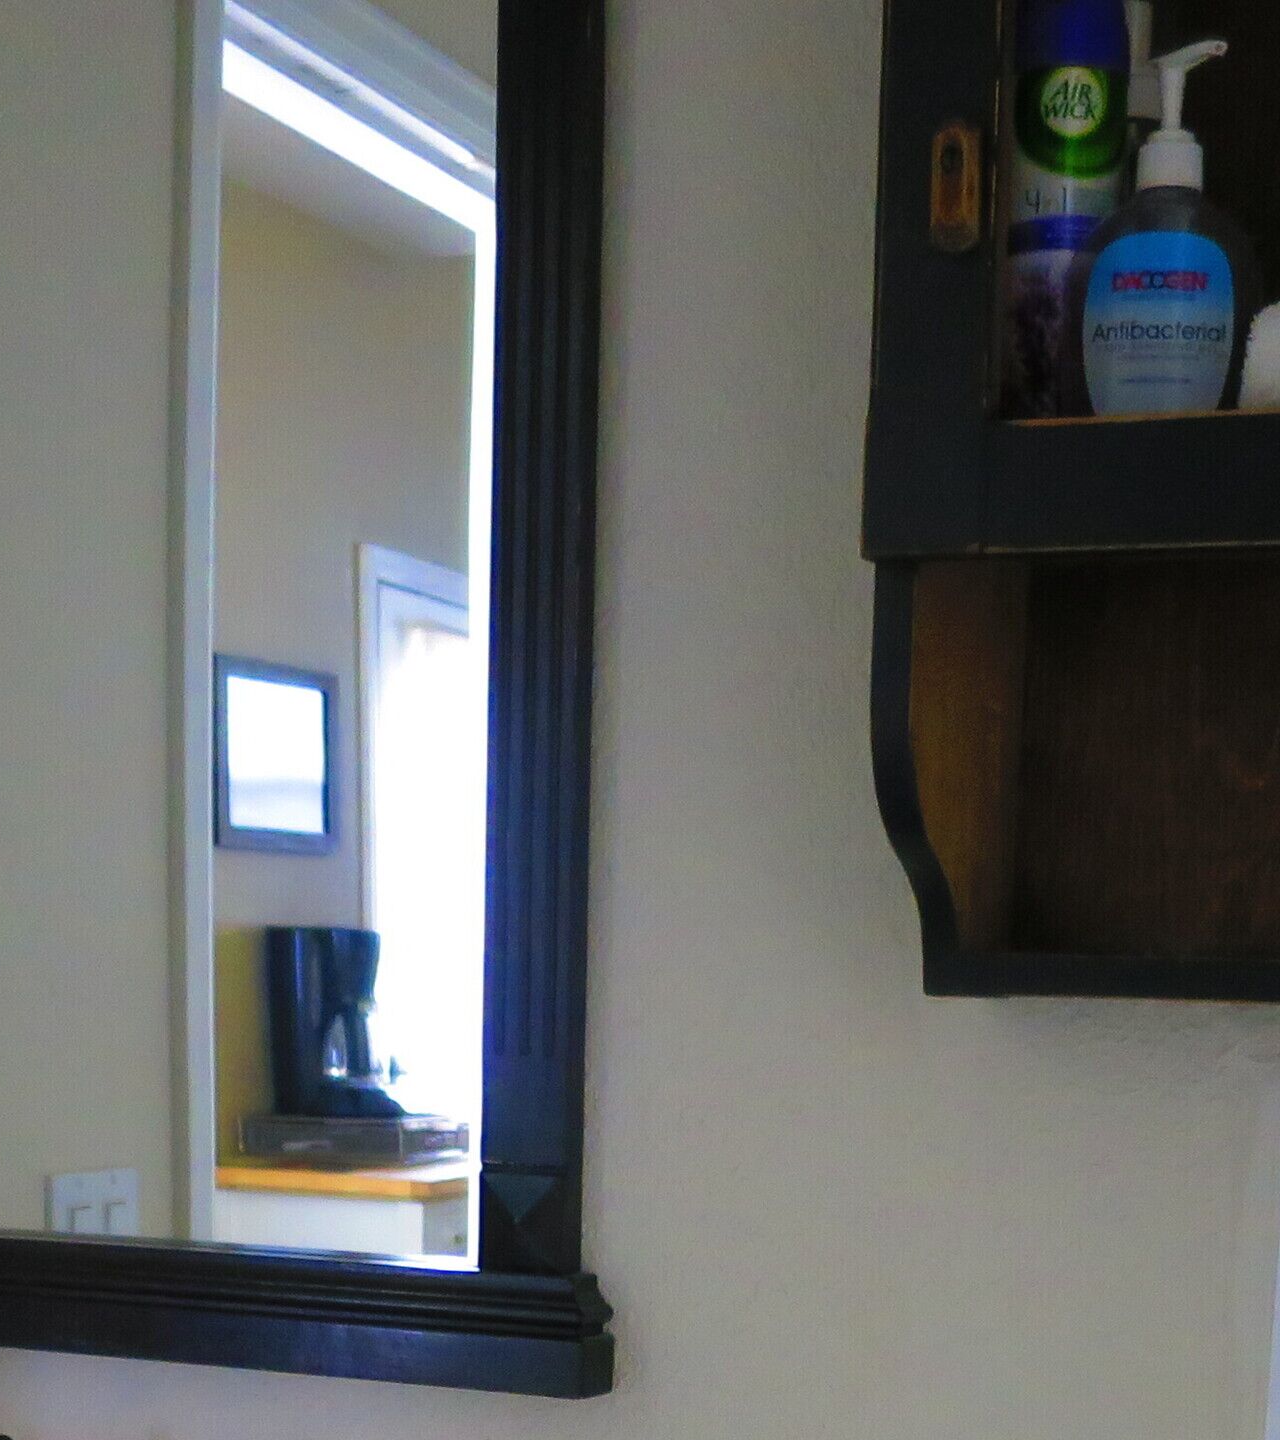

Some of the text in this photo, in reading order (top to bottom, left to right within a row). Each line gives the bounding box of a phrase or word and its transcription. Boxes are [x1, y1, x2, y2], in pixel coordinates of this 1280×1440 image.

[1050, 78, 1092, 101] AIR
[1043, 97, 1098, 121] WICK
[1092, 320, 1227, 343] Antibacterial
